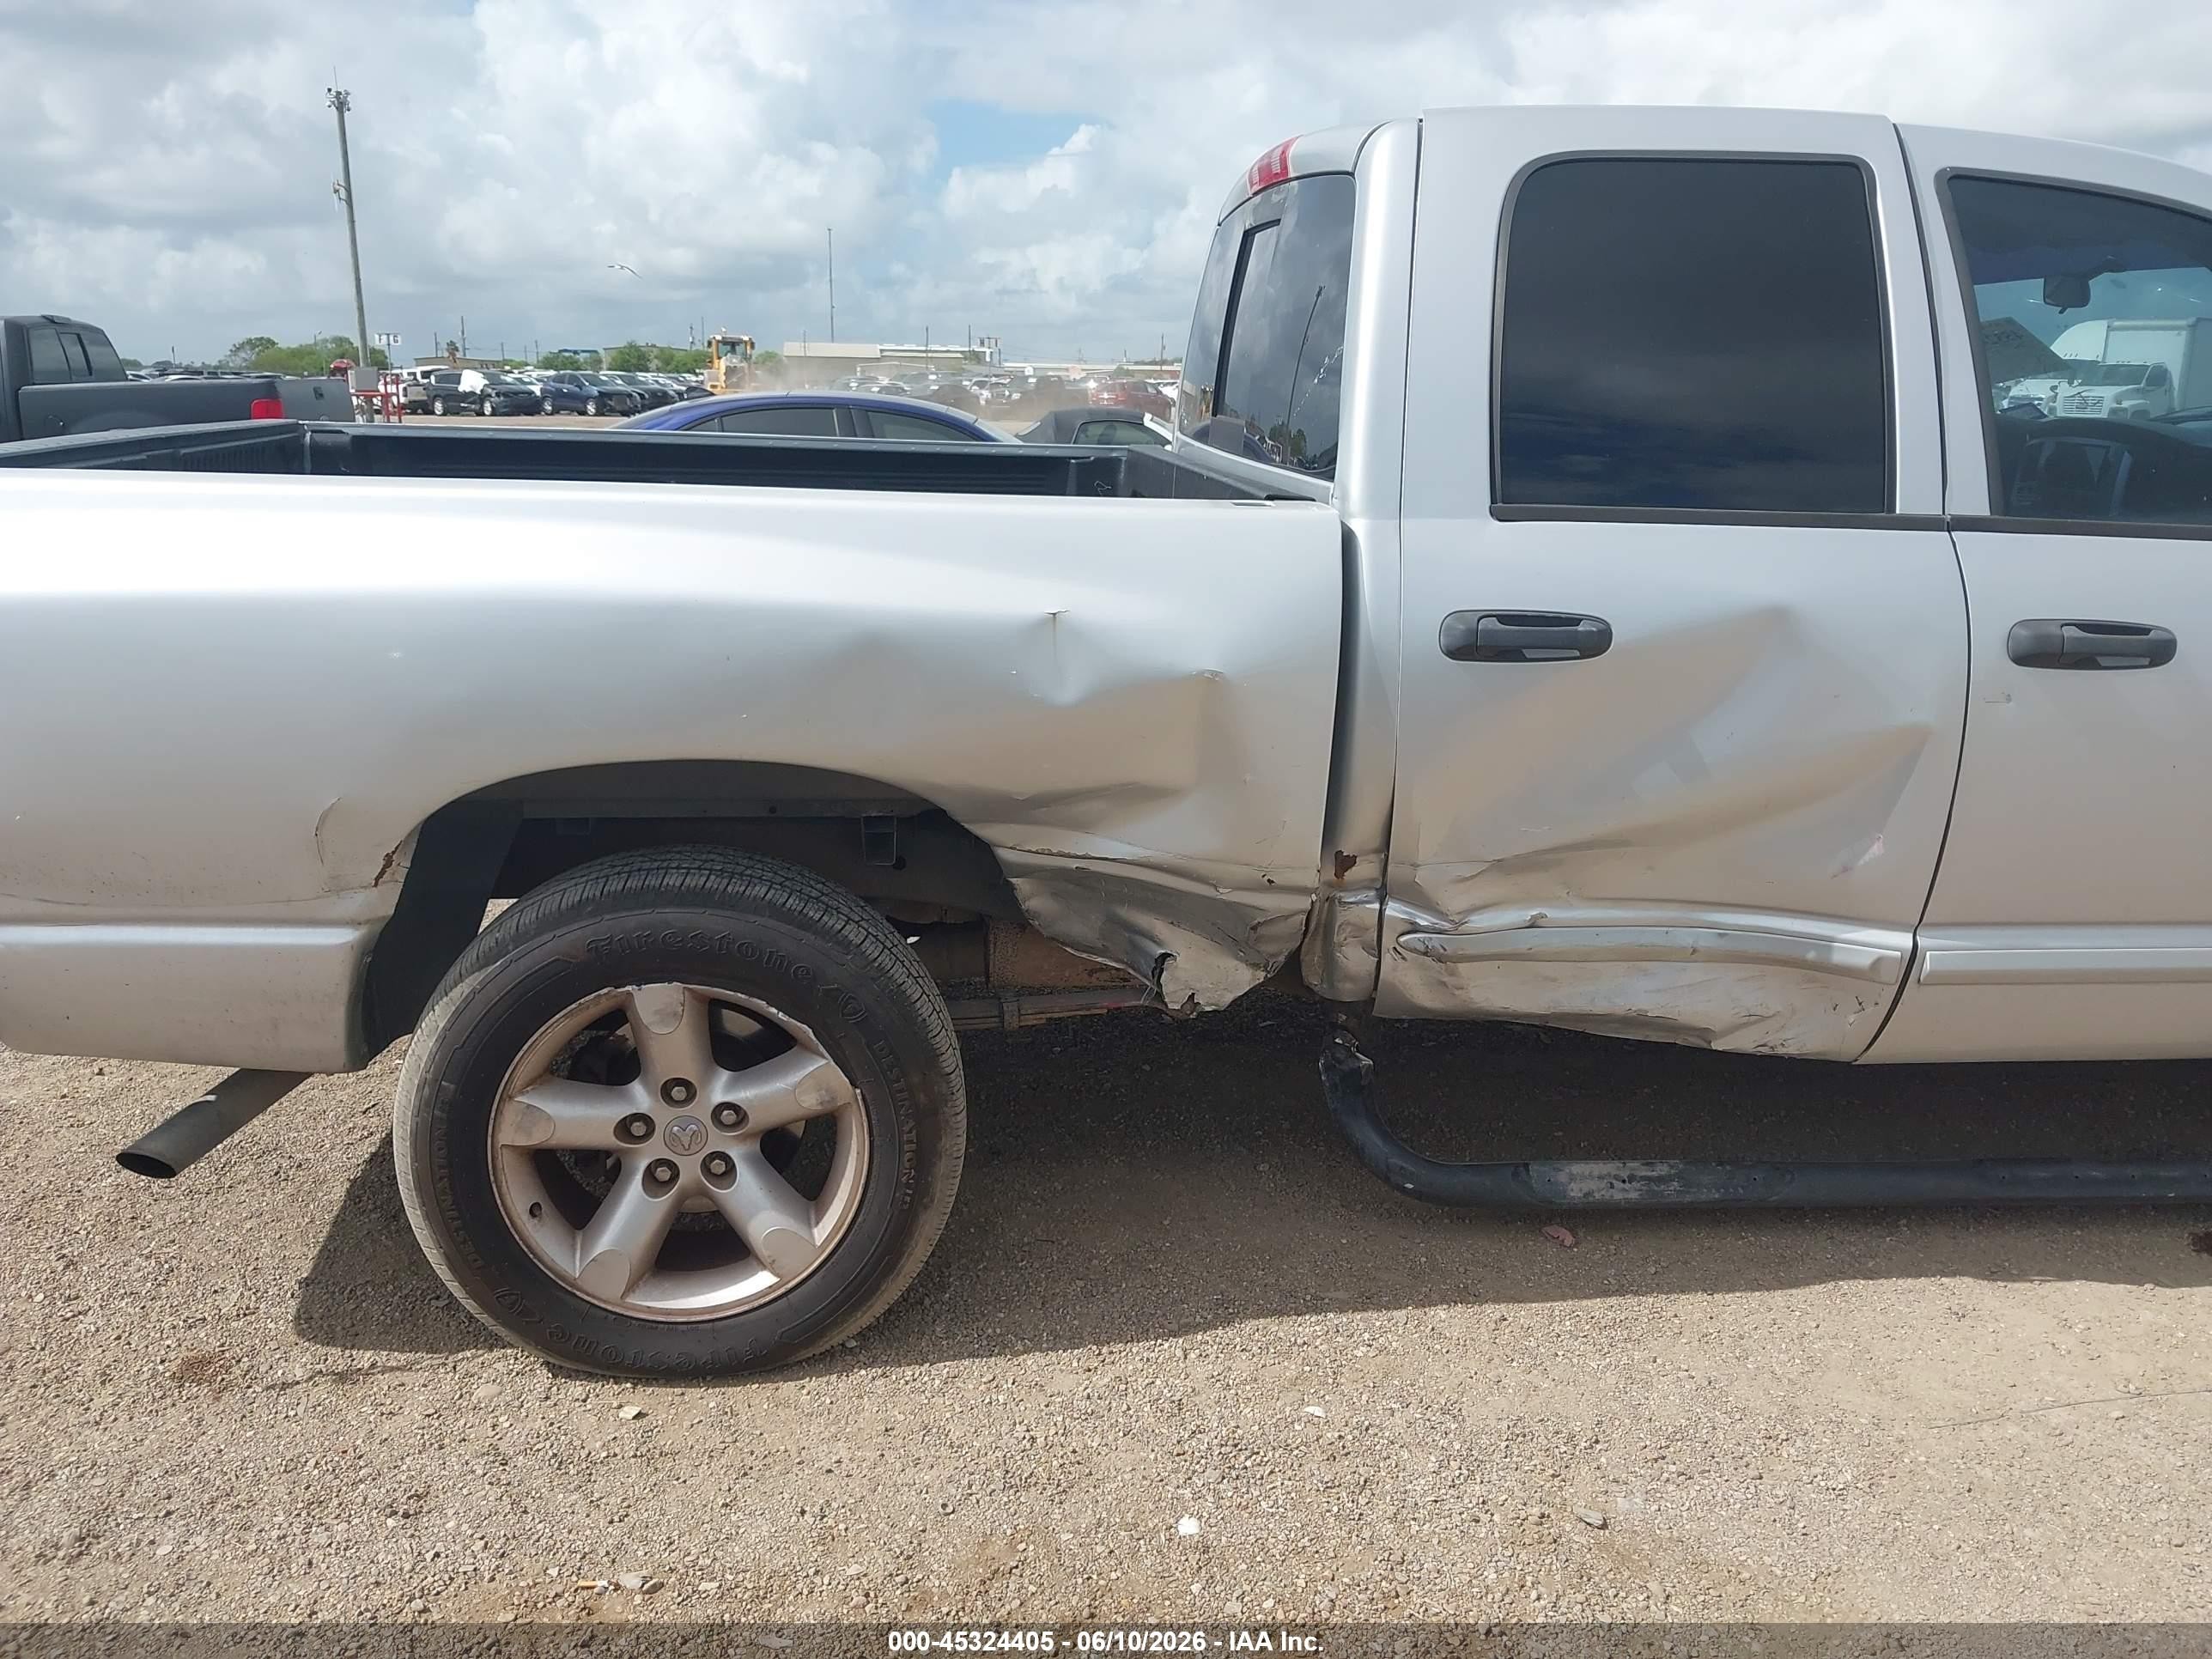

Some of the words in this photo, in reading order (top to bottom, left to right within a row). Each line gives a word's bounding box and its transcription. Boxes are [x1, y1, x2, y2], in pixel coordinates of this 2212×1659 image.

[586, 929, 813, 983] Firestone
[873, 1040, 917, 1183] DESTINATION
[546, 1323, 769, 1371] Firestone
